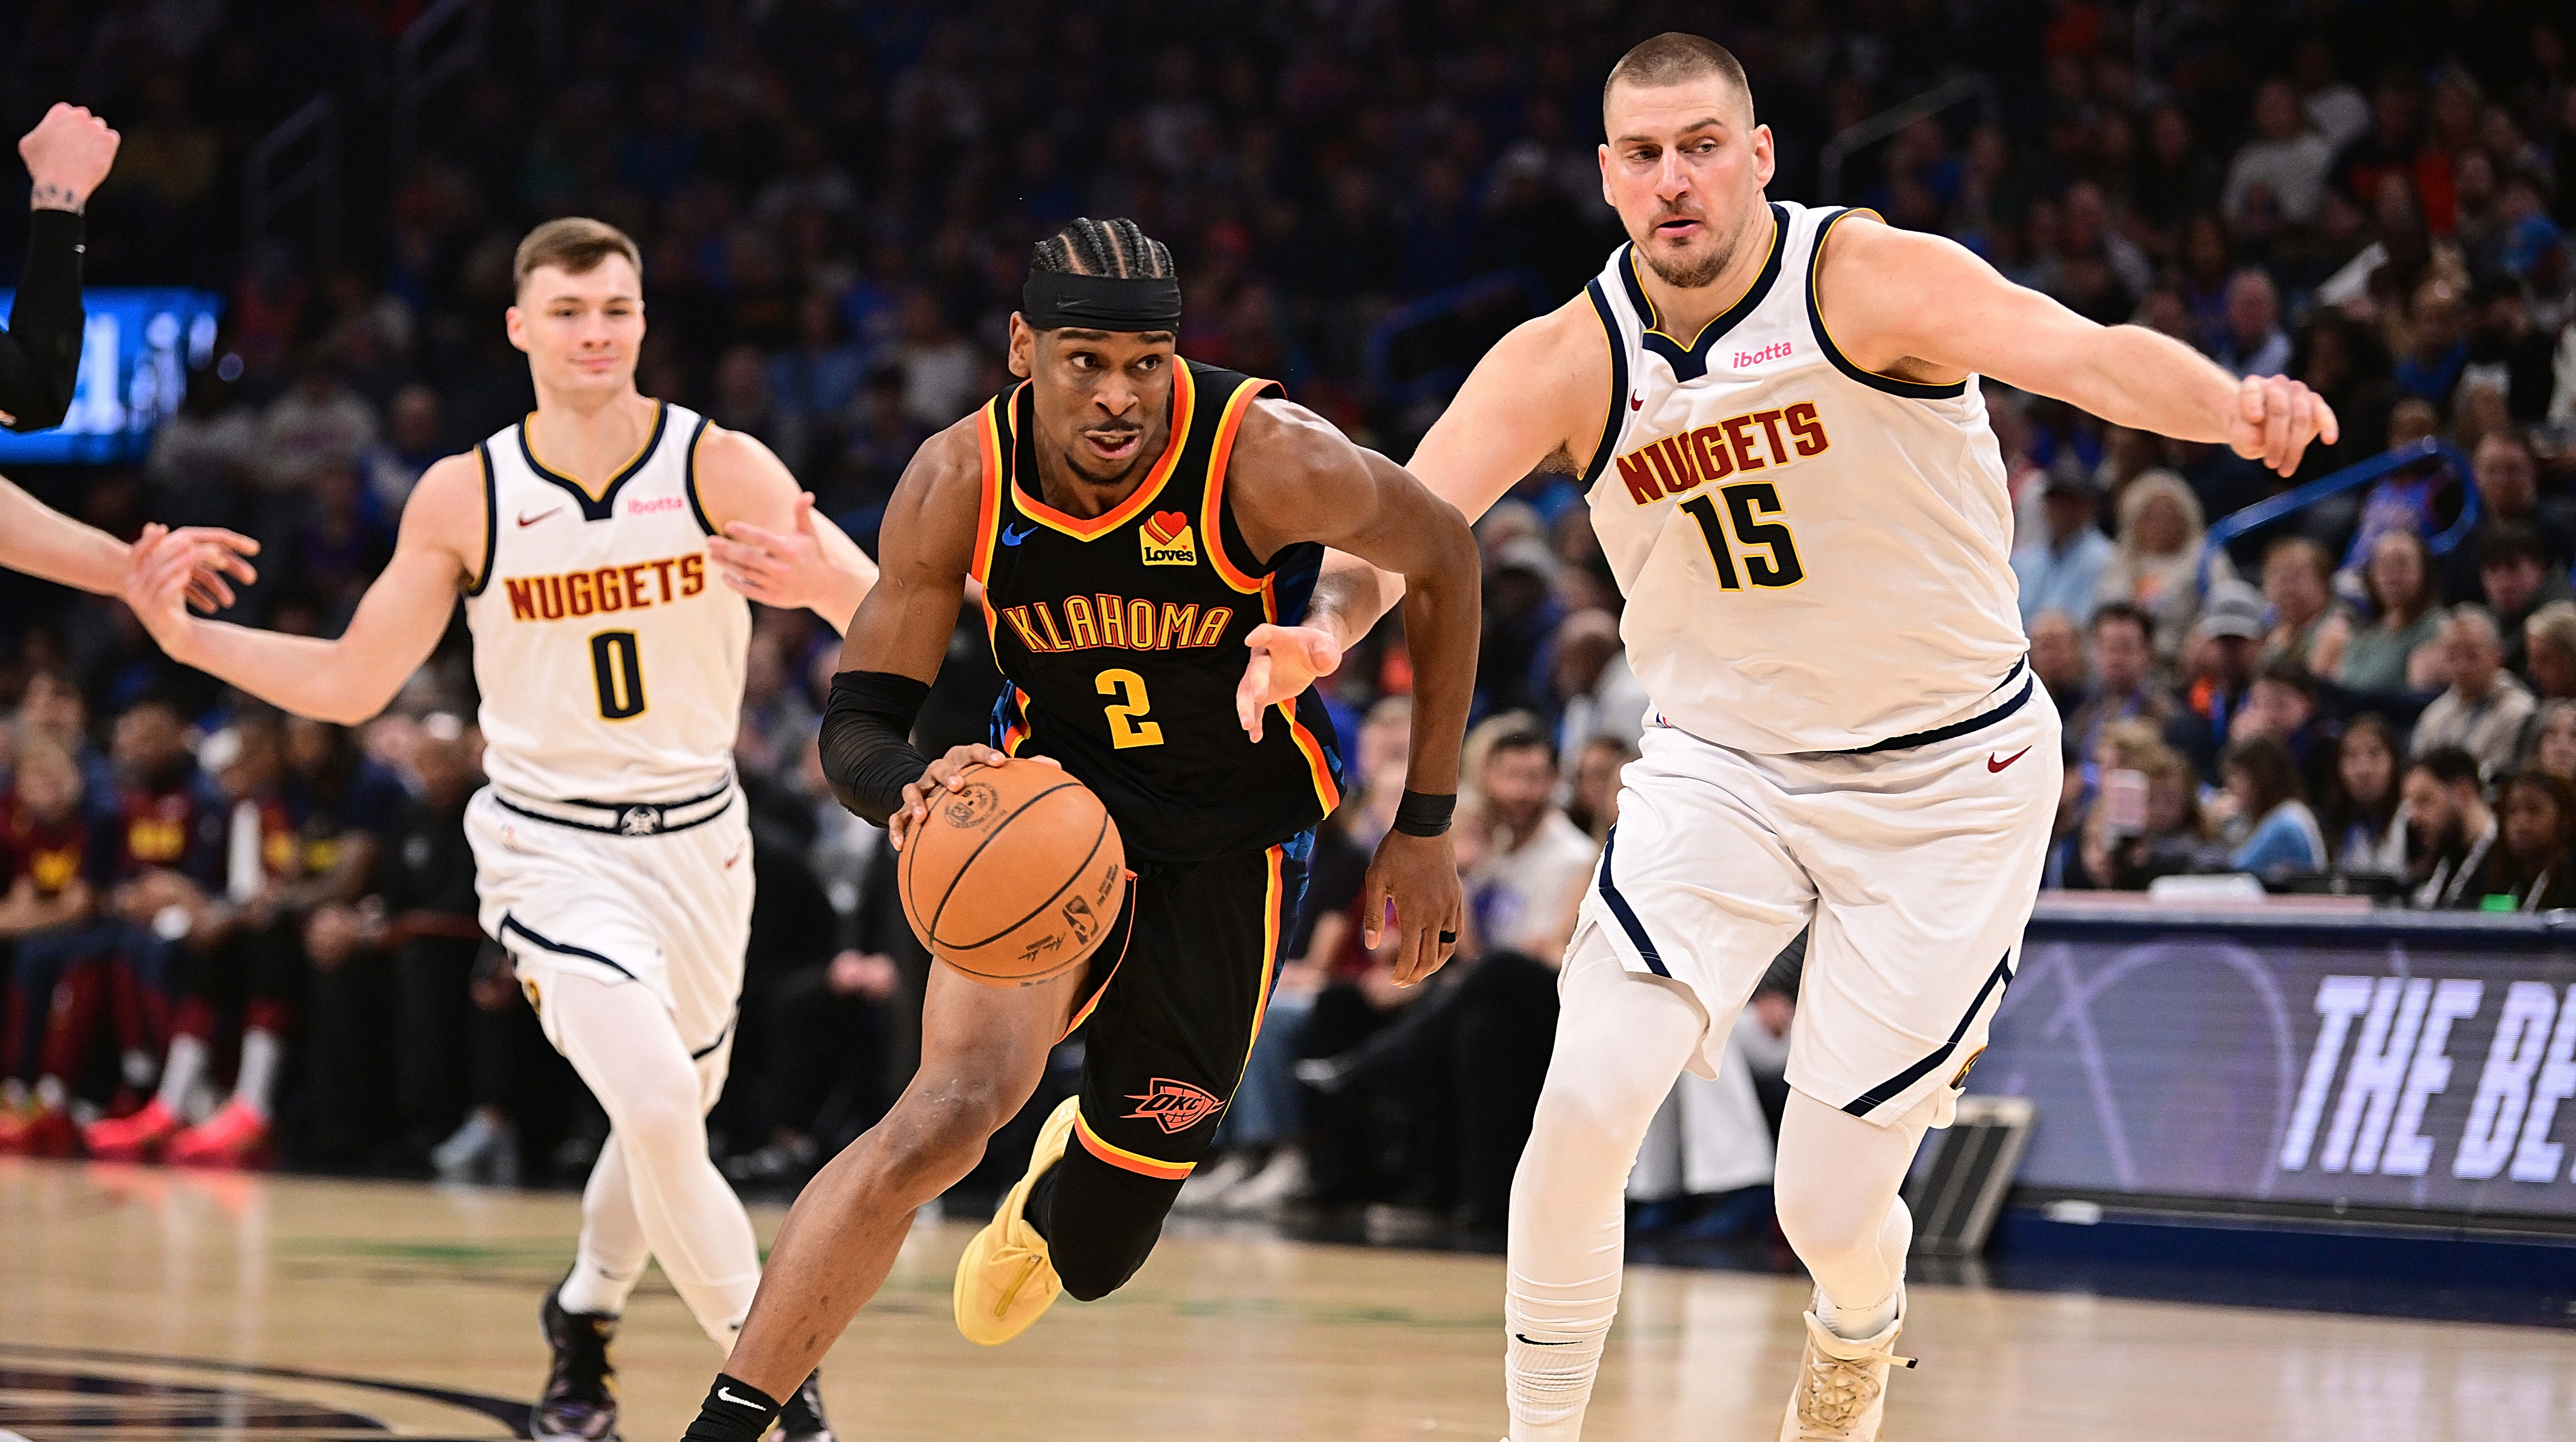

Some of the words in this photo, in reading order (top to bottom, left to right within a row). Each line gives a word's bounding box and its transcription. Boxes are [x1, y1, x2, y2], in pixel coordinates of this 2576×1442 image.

[1733, 342, 1792, 369] ibotta
[1676, 481, 1807, 592] 15
[504, 551, 704, 622] NUGGETS
[997, 593, 1233, 652] KLAHOMA
[588, 626, 649, 723] 0
[1095, 669, 1164, 749] 2
[1140, 1094, 1203, 1111] OKC
[2279, 975, 2485, 1178] THE
[2452, 981, 2576, 1183] BE
